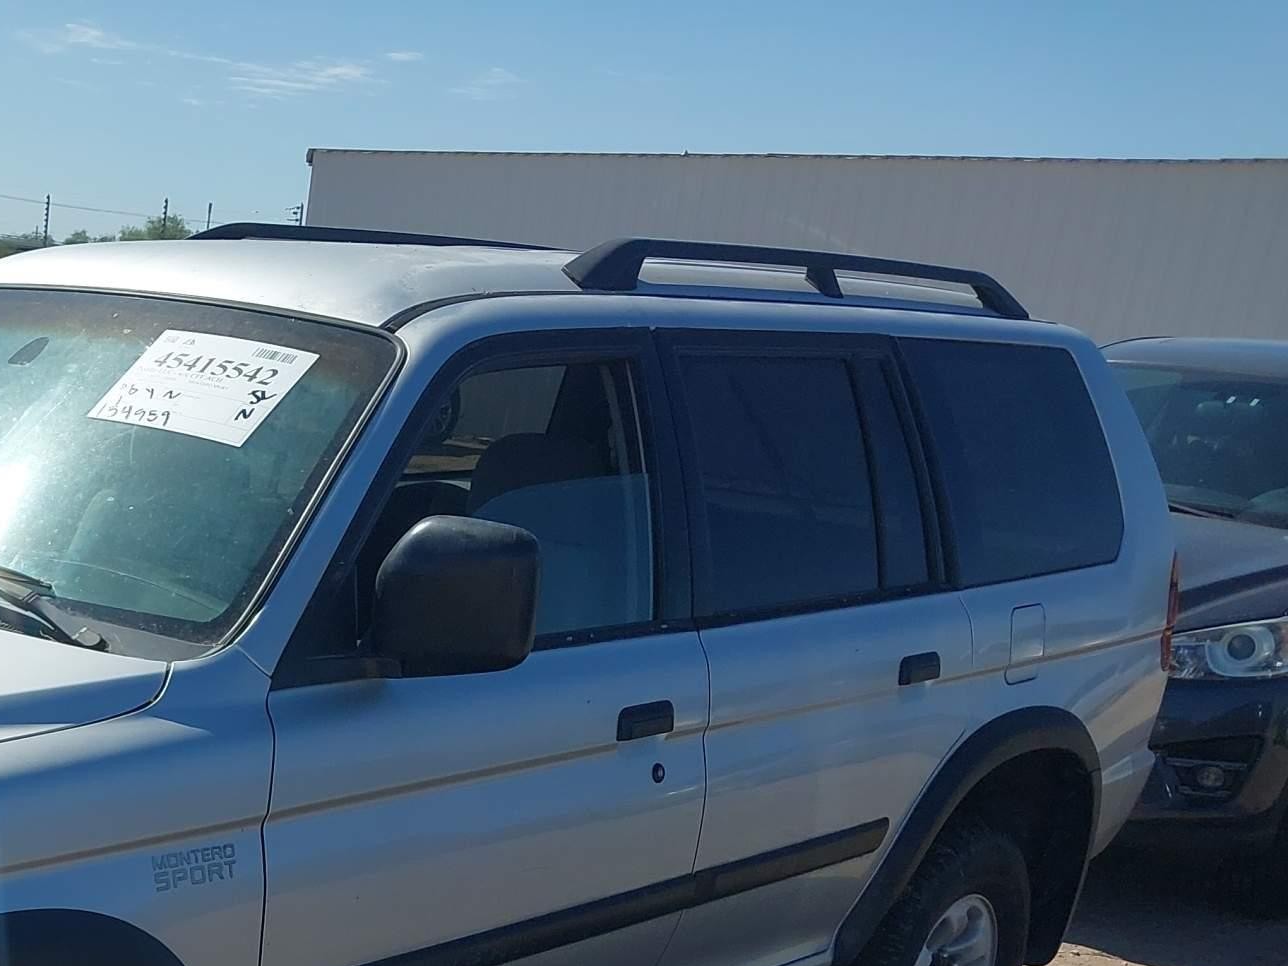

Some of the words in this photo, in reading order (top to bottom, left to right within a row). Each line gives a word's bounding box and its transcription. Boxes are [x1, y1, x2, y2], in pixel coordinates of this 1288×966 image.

[154, 351, 279, 386] 45415542
[152, 843, 236, 871] MONTERO
[153, 860, 237, 893] SPORT
